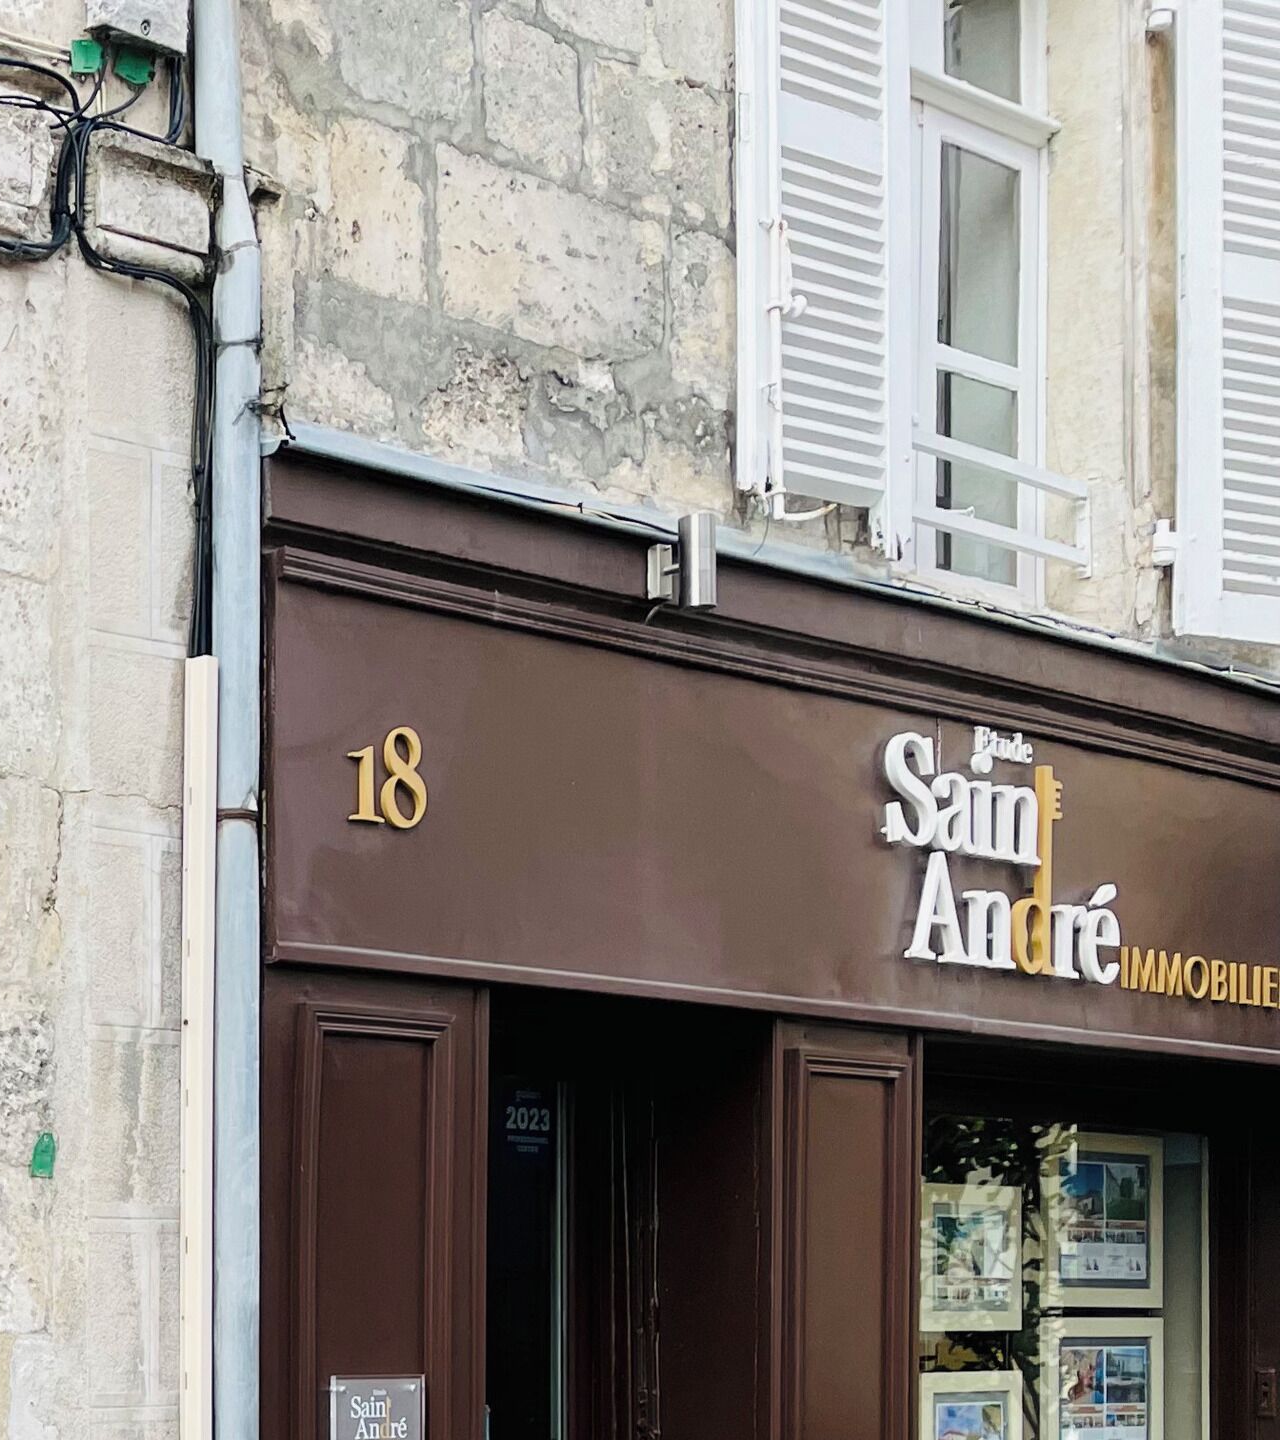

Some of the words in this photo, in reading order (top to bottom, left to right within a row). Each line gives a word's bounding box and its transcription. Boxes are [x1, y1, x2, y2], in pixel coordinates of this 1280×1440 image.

[346, 726, 428, 829] 18
[903, 850, 1122, 986] André
[1119, 945, 1280, 1010] IMMOBILIE
[505, 1105, 550, 1131] 2023
[354, 1417, 408, 1440] André
